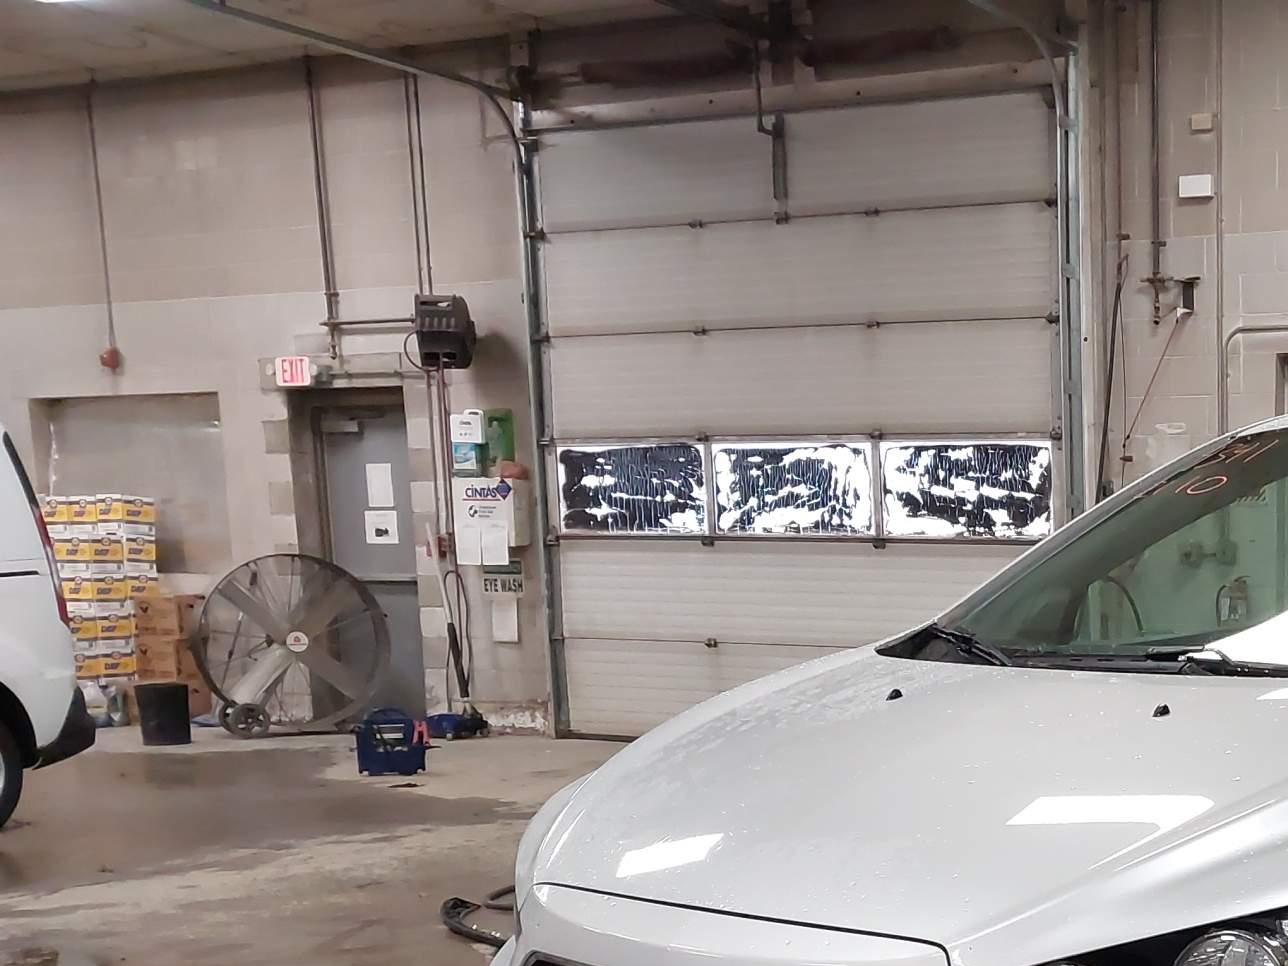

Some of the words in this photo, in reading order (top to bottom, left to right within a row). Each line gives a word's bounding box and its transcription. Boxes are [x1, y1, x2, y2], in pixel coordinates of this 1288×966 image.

[281, 359, 305, 383] EXIT
[484, 578, 499, 592] EYE
[500, 578, 523, 592] WASH
